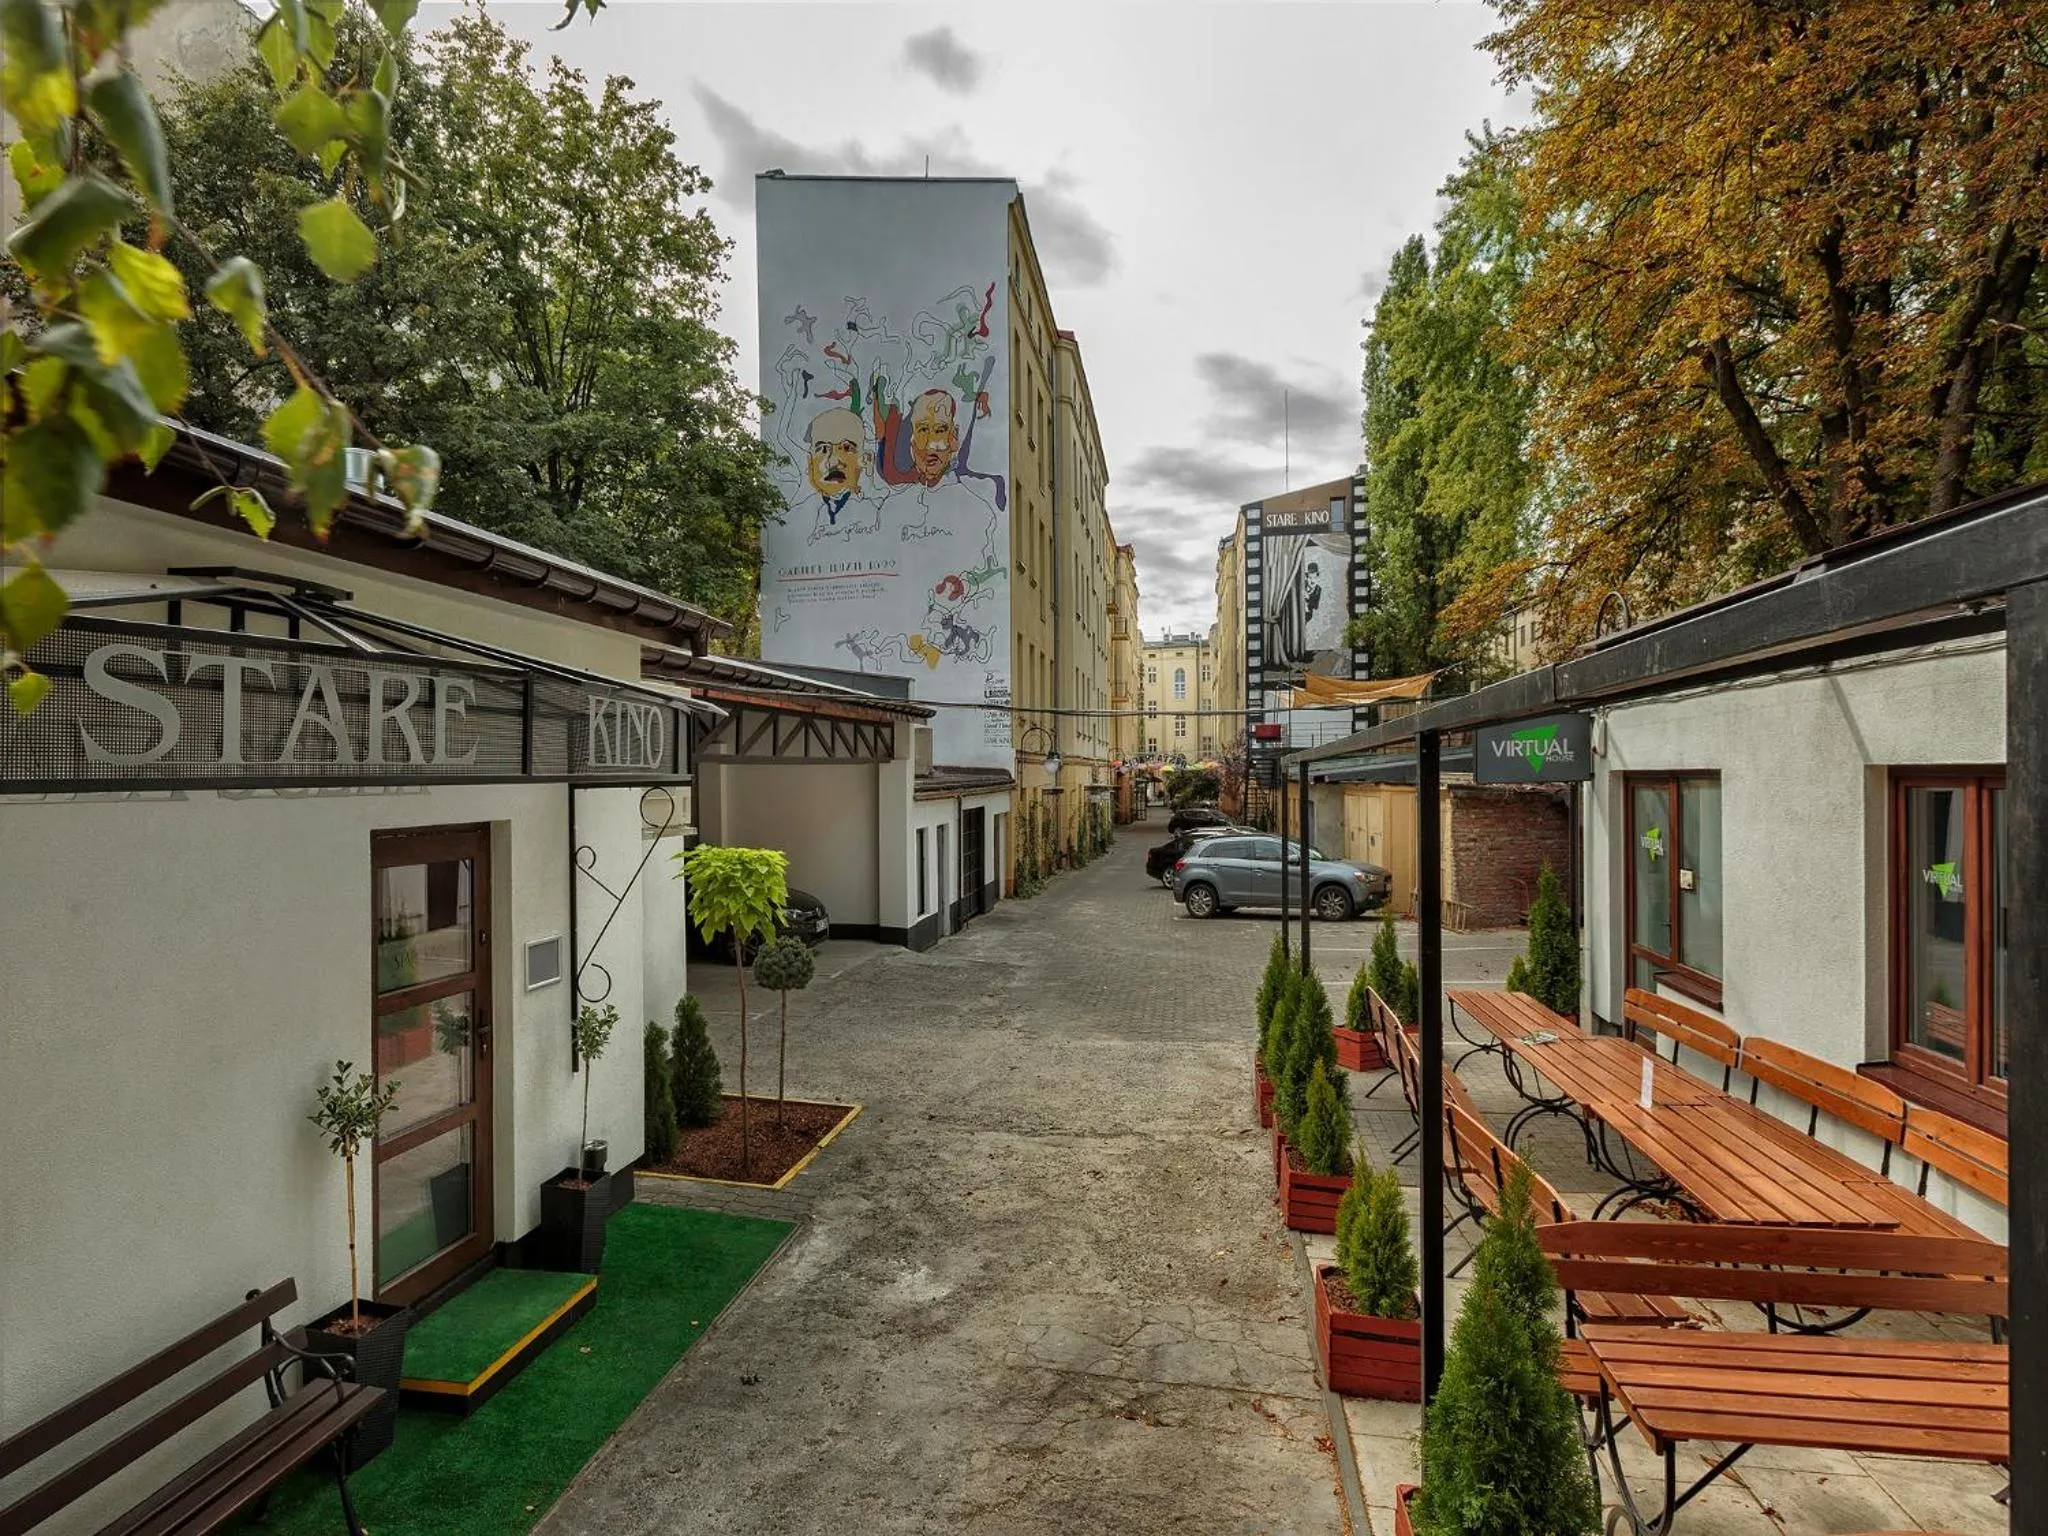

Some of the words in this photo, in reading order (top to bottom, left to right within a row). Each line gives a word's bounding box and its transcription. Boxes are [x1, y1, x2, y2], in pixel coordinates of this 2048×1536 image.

[1266, 512, 1298, 528] STARE
[1304, 510, 1330, 525] KINO
[79, 643, 479, 766] STARE
[587, 694, 666, 769] KINO
[1491, 738, 1575, 758] VIRTUAL
[1545, 754, 1575, 763] HOUSE
